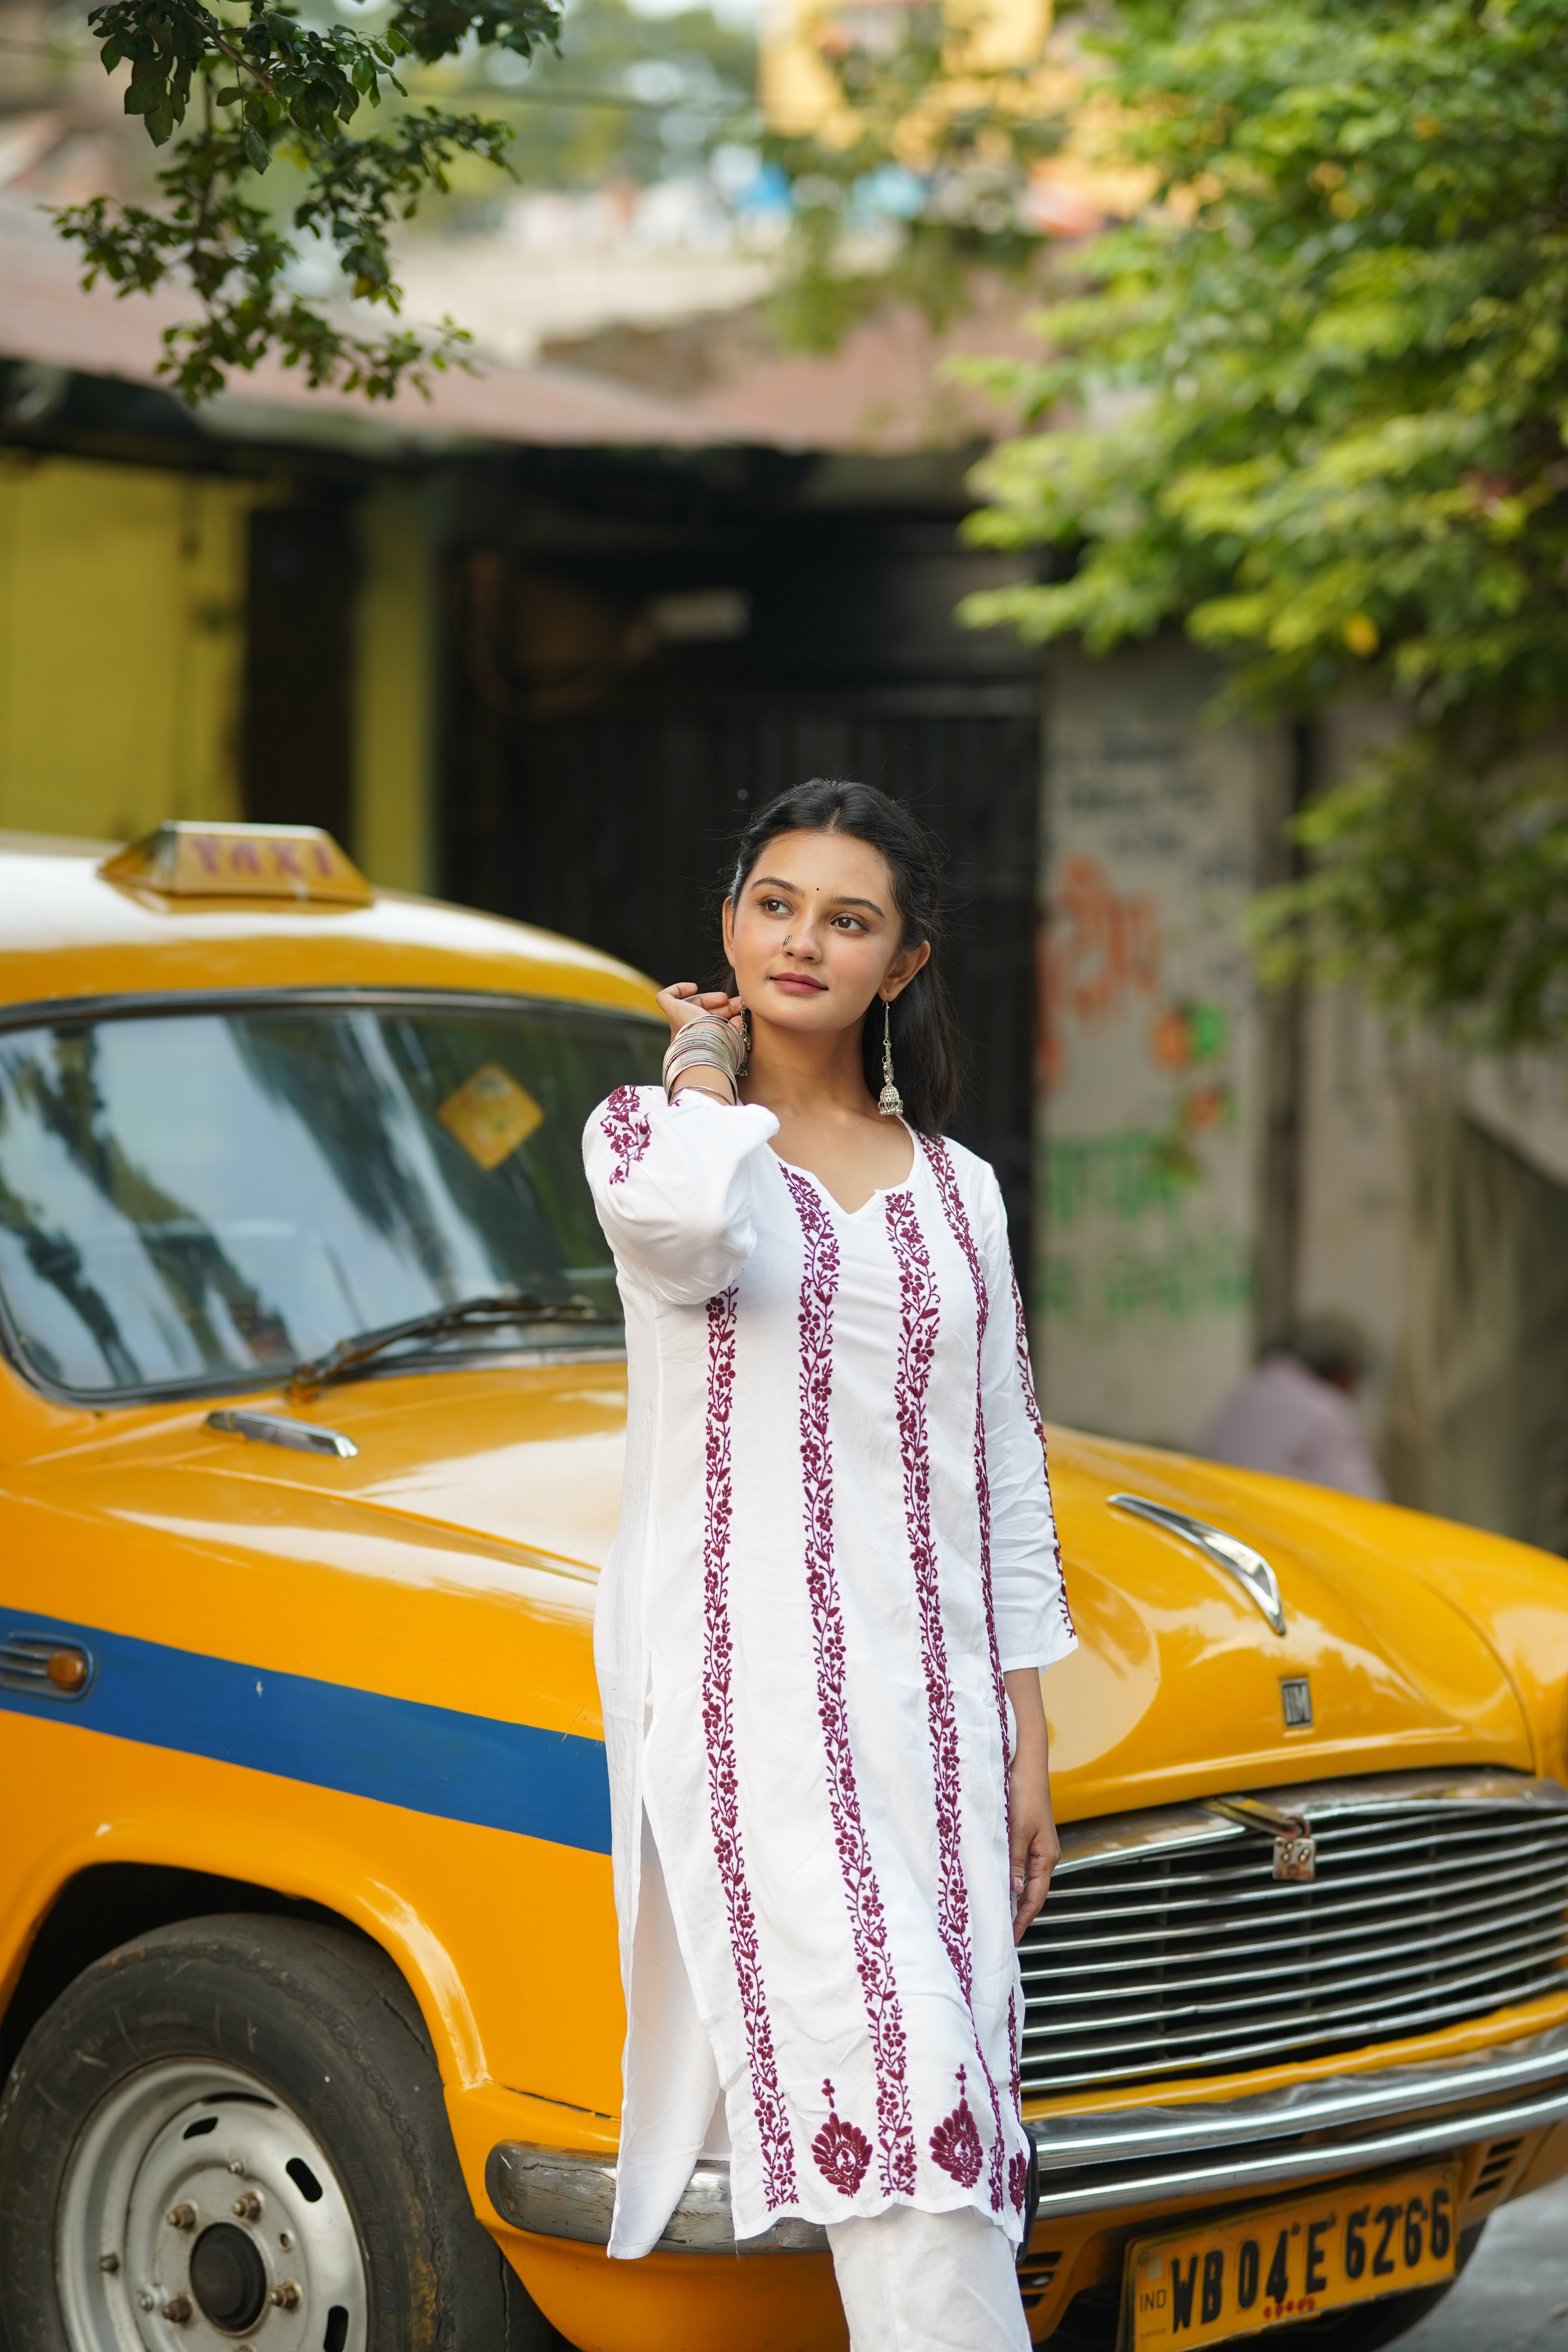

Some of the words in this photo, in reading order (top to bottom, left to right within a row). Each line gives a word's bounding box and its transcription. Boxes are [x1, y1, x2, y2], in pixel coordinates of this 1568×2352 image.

[191, 838, 332, 878] TAXI
[1171, 2250, 1224, 2333] WB
[1345, 2188, 1450, 2279] 6266
[1140, 2288, 1166, 2313] IND
